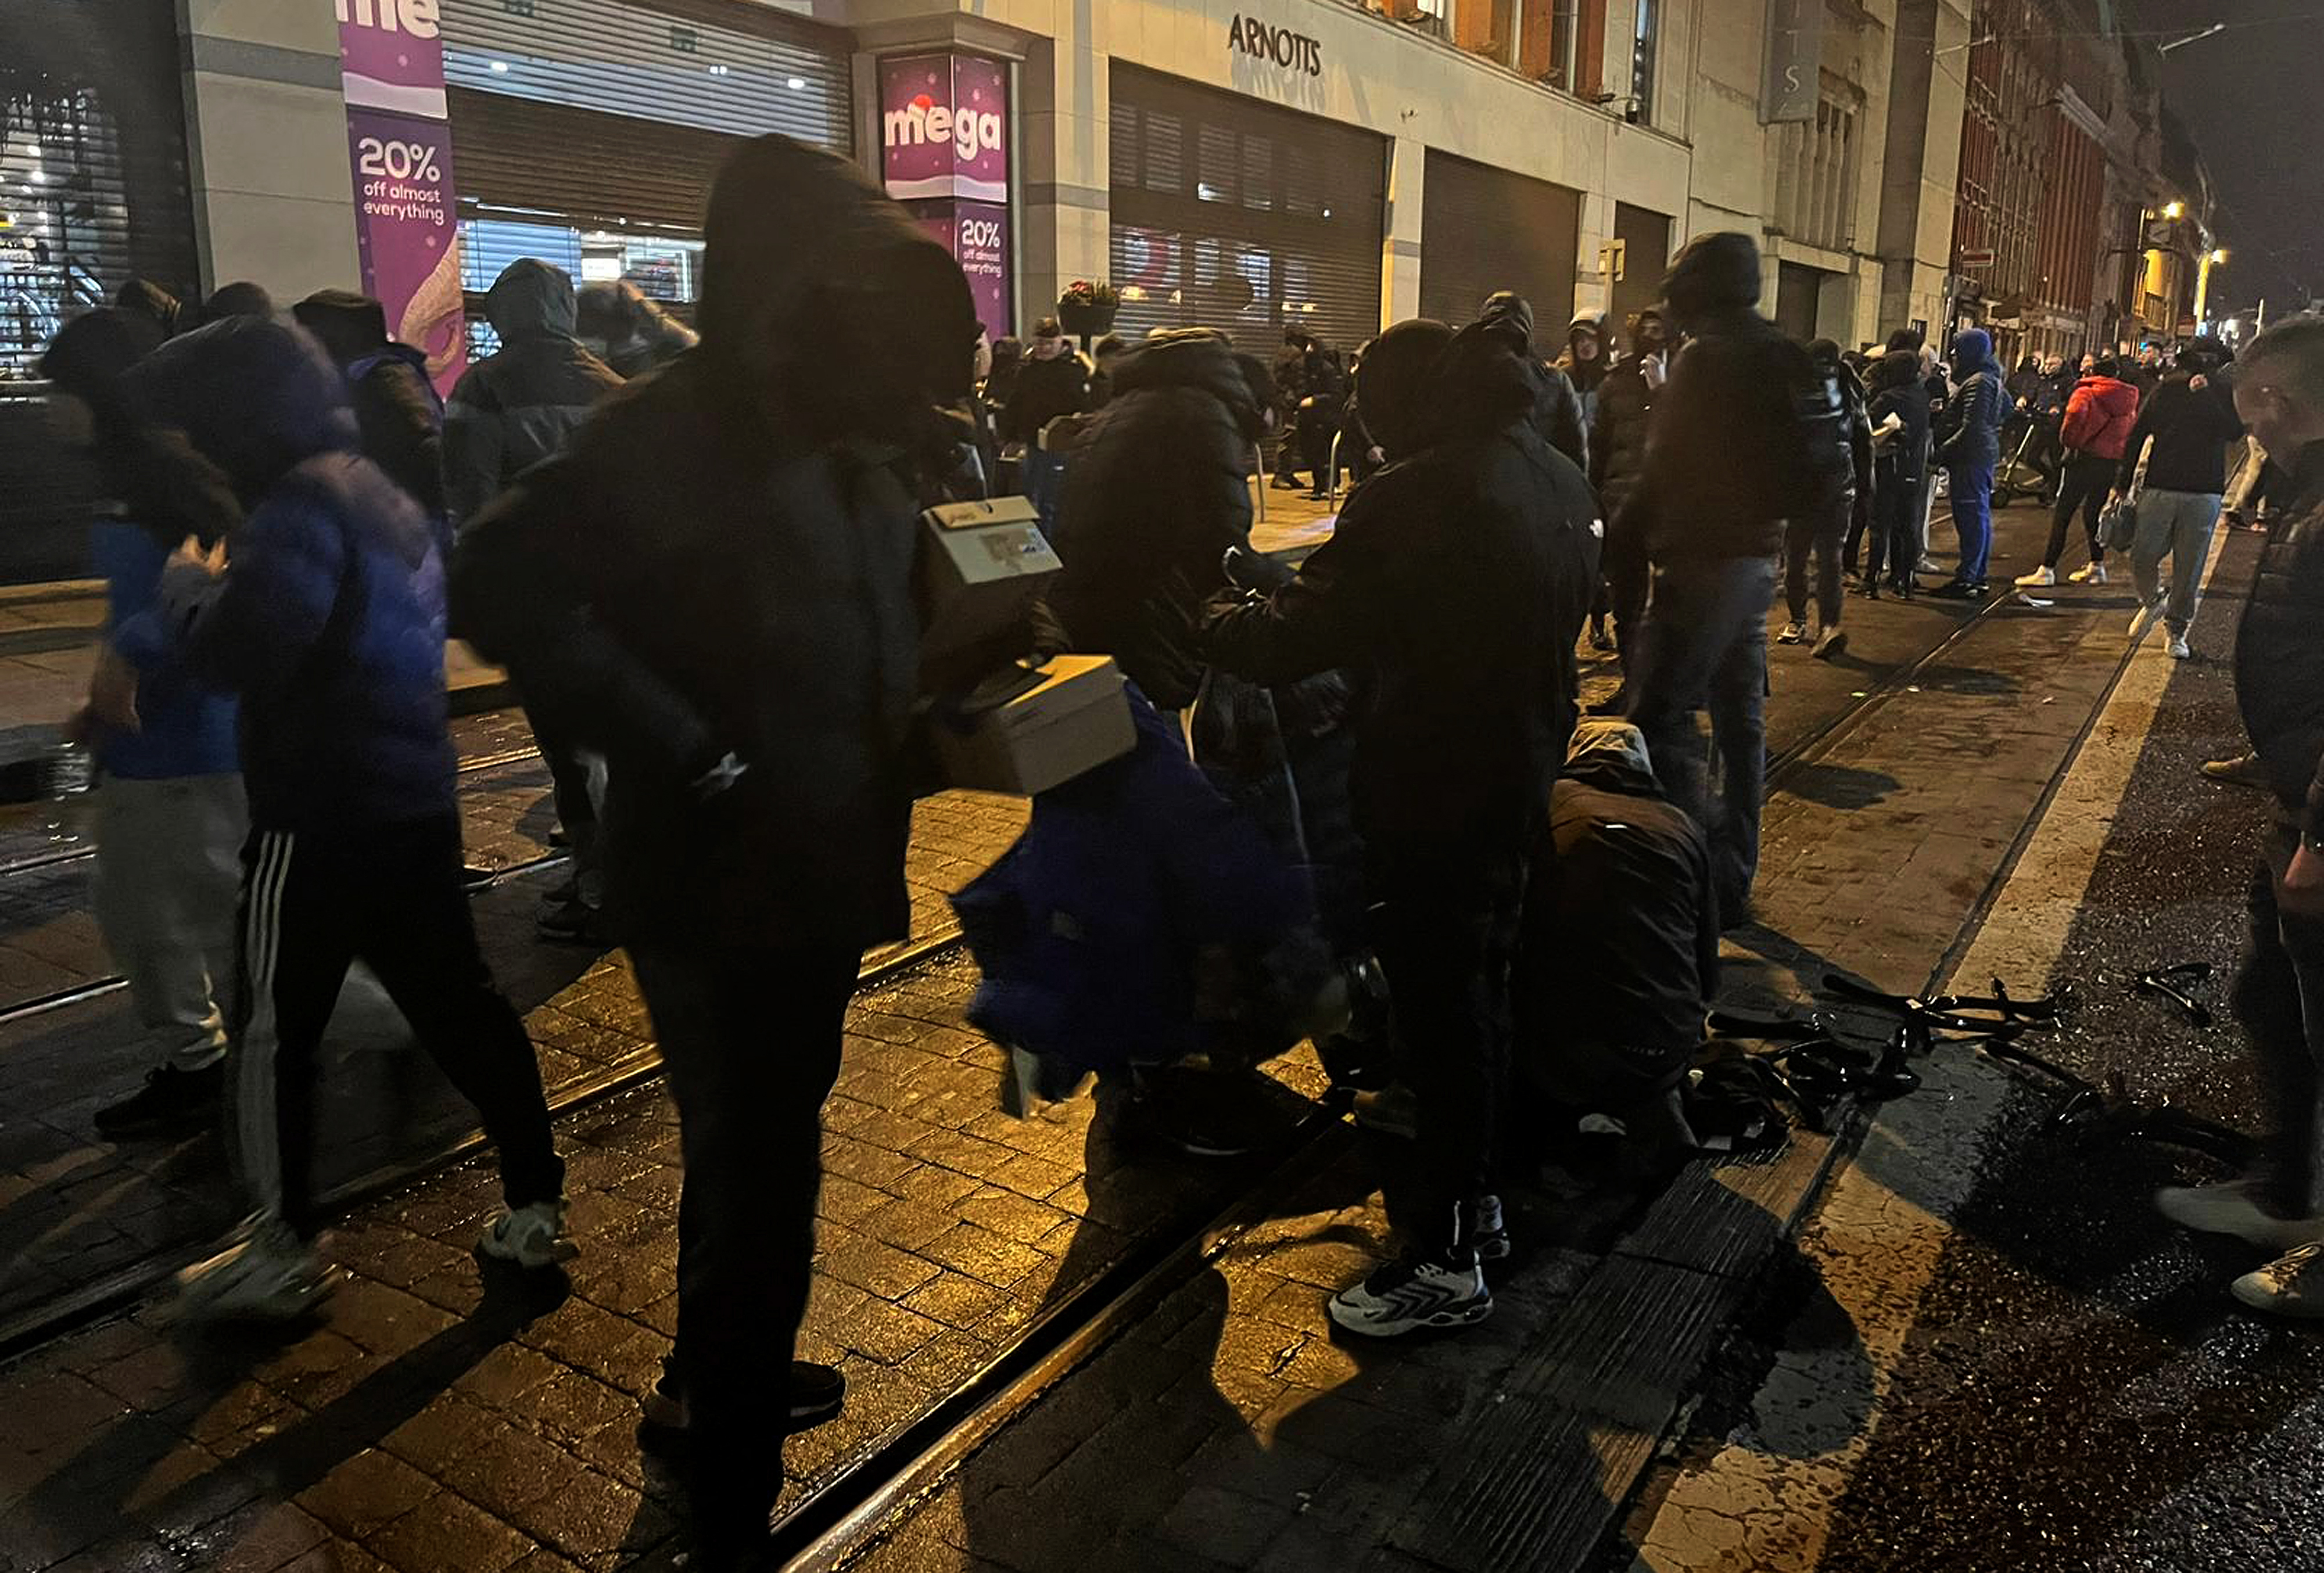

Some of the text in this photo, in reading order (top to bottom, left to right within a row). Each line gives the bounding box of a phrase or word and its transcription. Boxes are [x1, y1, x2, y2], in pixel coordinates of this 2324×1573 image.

[1227, 13, 1321, 77] ARNOTTS
[884, 102, 1000, 161] mega
[358, 137, 441, 182] 20%
[363, 181, 442, 203] off almost
[363, 201, 444, 226] everything
[962, 219, 1000, 248] 20%
